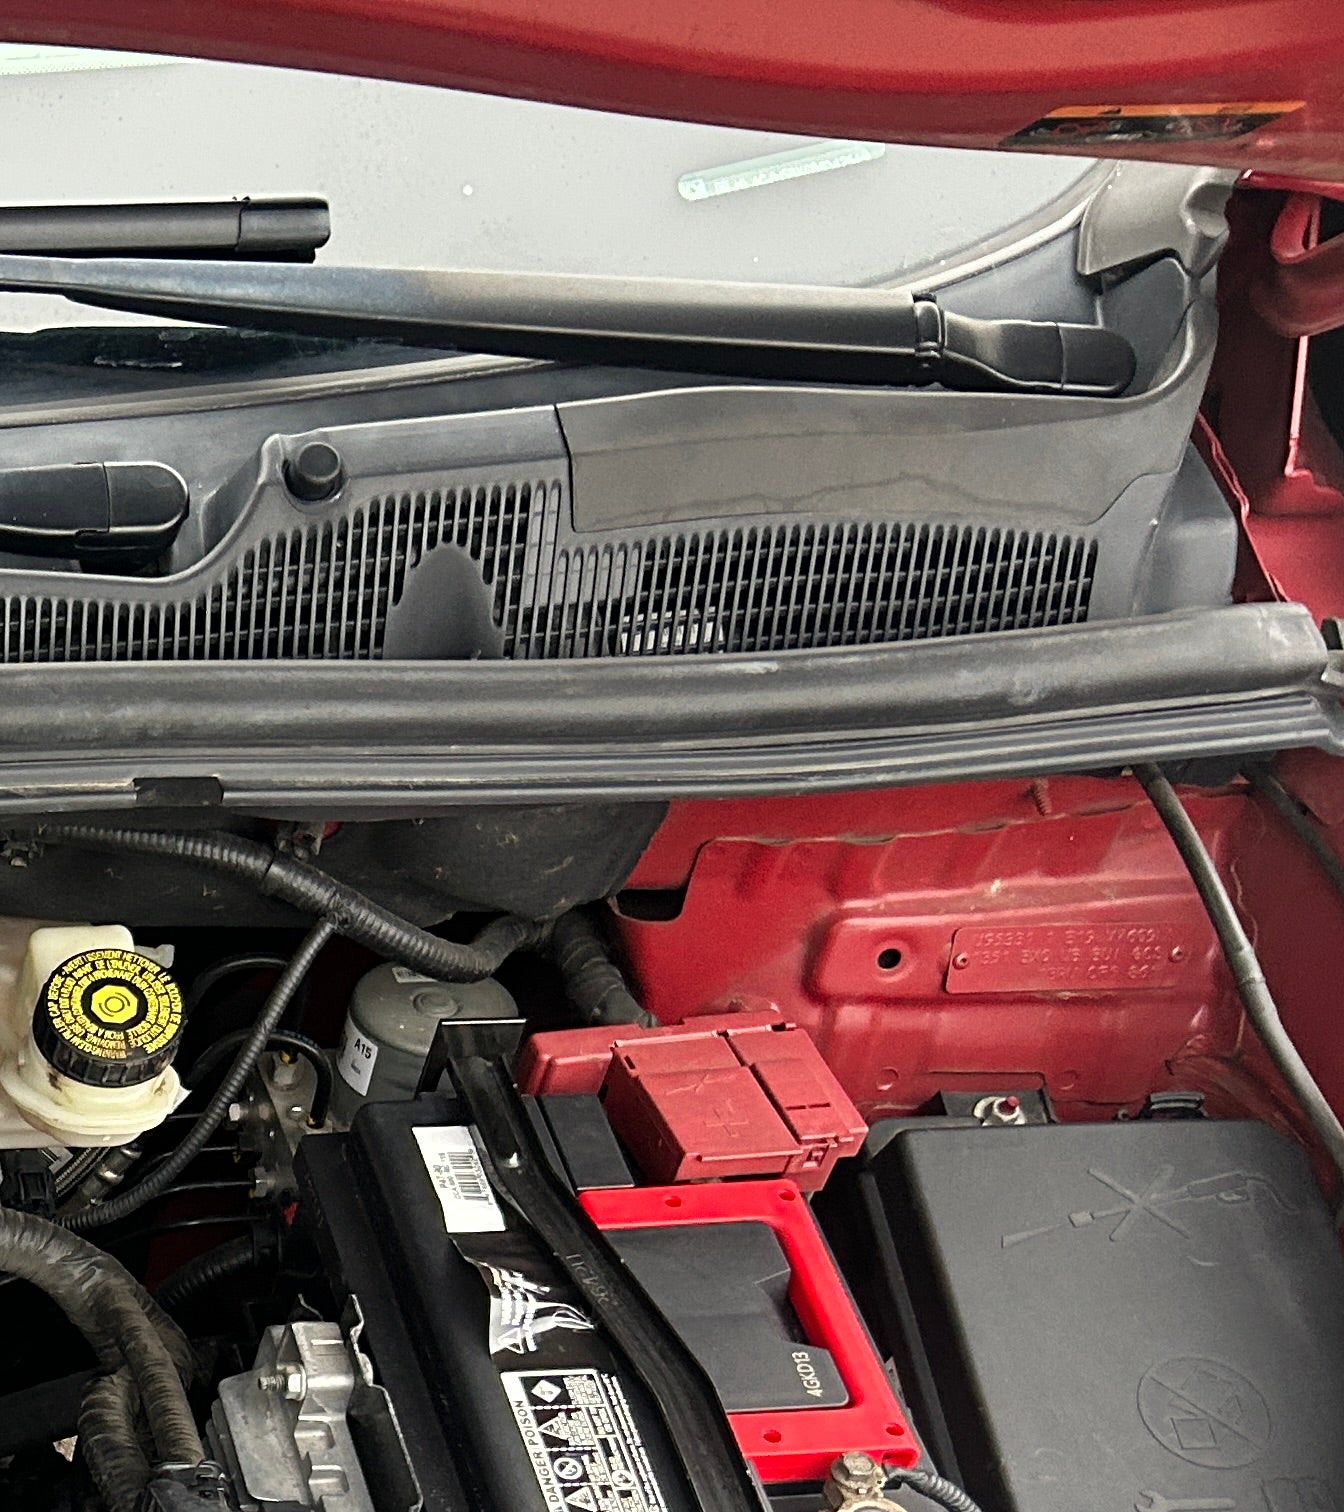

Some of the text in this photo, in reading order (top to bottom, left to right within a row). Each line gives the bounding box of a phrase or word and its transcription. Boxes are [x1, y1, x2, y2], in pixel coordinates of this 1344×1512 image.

[72, 963, 92, 978] AVANT
[95, 960, 105, 968] DE
[122, 952, 160, 973] NETTOYER
[158, 972, 171, 983] LE
[47, 974, 64, 999] BEFORE
[48, 1002, 58, 1016] CAP
[61, 1009, 74, 1024] ONLY
[53, 1017, 73, 1039] FILLER
[69, 1023, 85, 1036] USE
[354, 1038, 372, 1059] A15
[792, 1351, 823, 1397] 4GKD13
[512, 1400, 560, 1503] DANGER POISON
